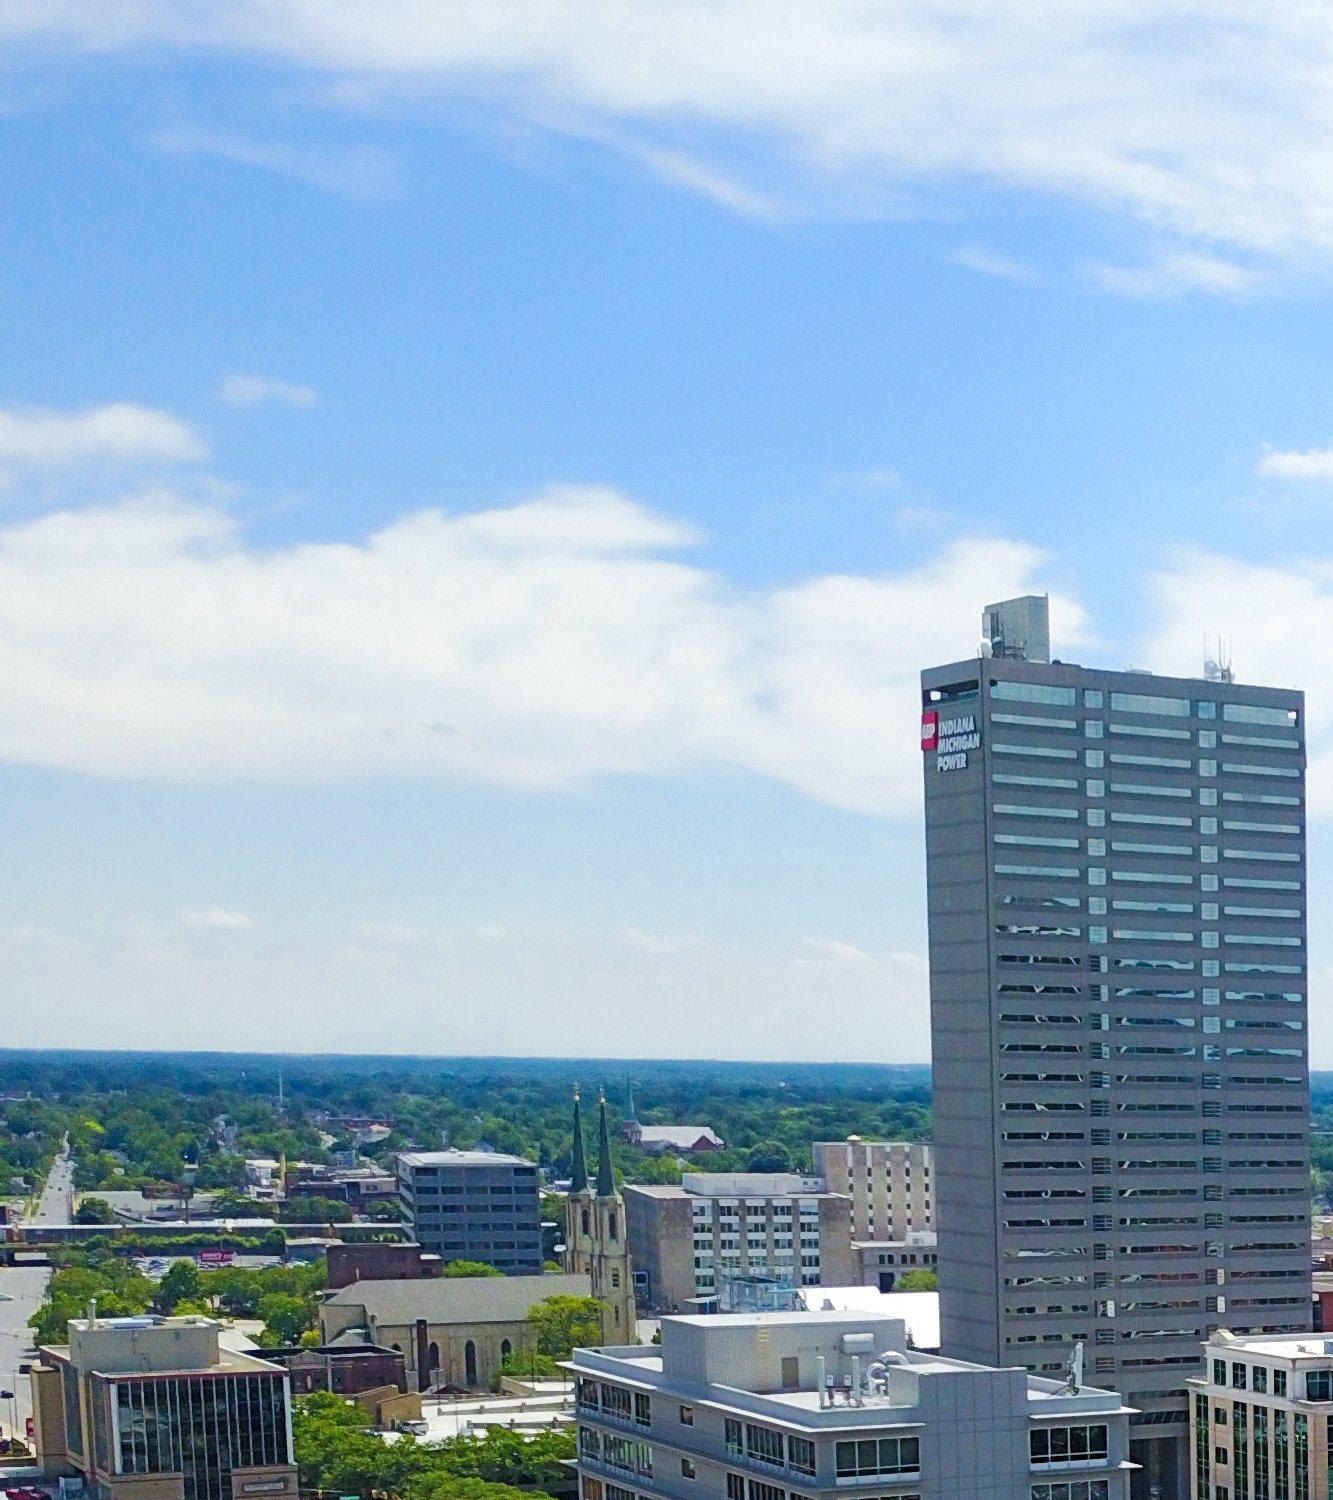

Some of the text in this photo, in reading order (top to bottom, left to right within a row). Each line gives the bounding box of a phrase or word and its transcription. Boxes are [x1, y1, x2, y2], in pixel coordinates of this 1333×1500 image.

[939, 715, 975, 737] INDIANA
[937, 733, 980, 754] MICHIGAN
[937, 752, 967, 772] POWER
